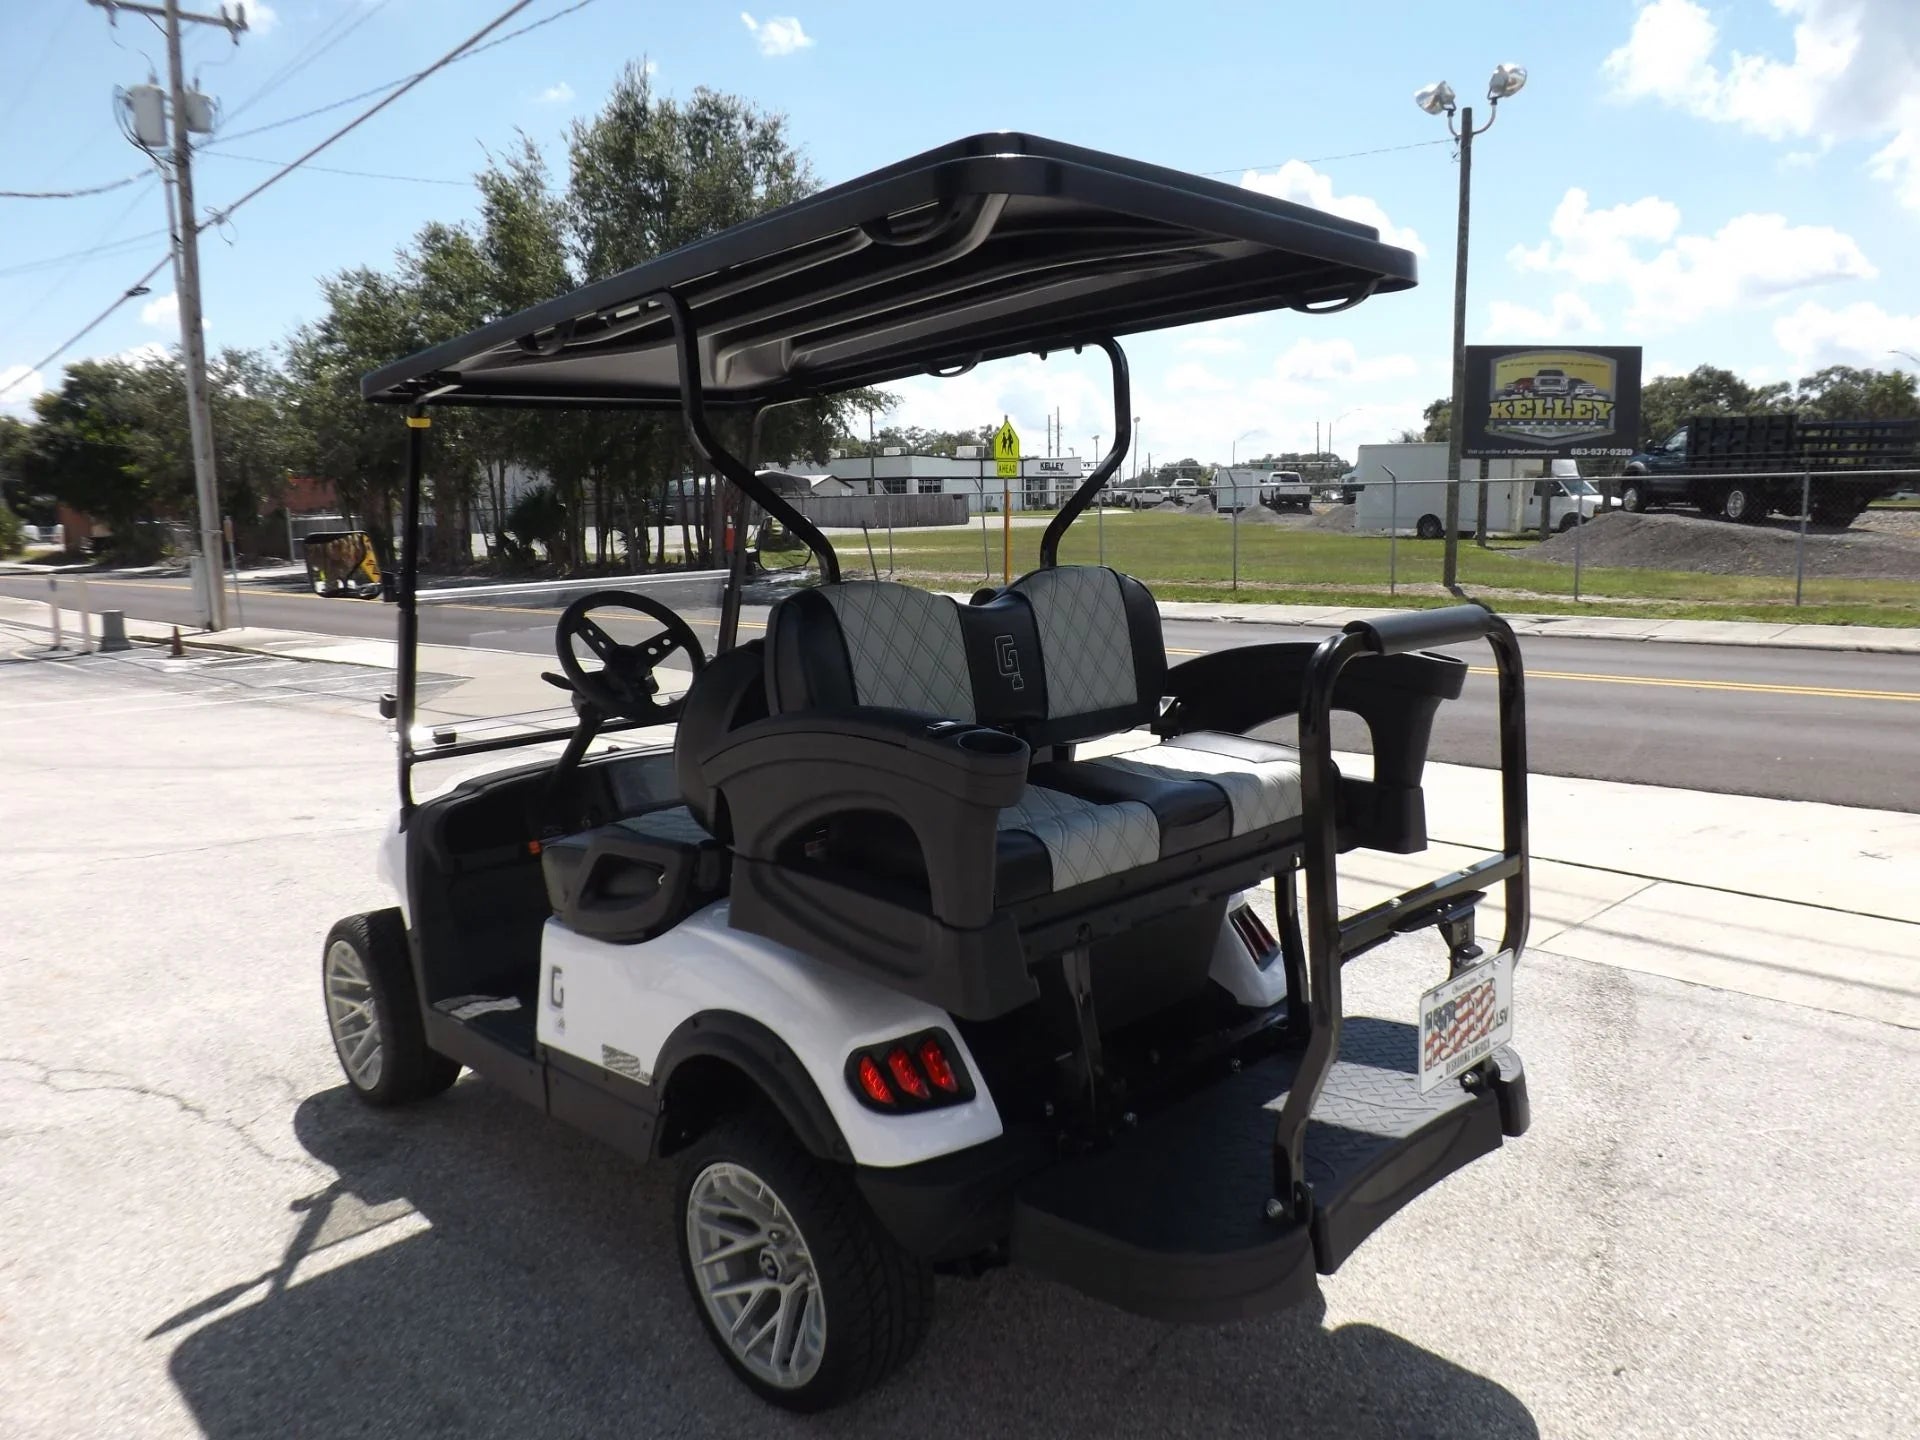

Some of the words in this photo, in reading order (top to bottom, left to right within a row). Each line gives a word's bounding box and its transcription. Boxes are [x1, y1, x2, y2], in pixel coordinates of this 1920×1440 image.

[1489, 399, 1616, 420] KELLEY
[999, 464, 1016, 474] AHEAD
[1040, 462, 1064, 471] KELLEY
[1495, 1006, 1509, 1031] LSV
